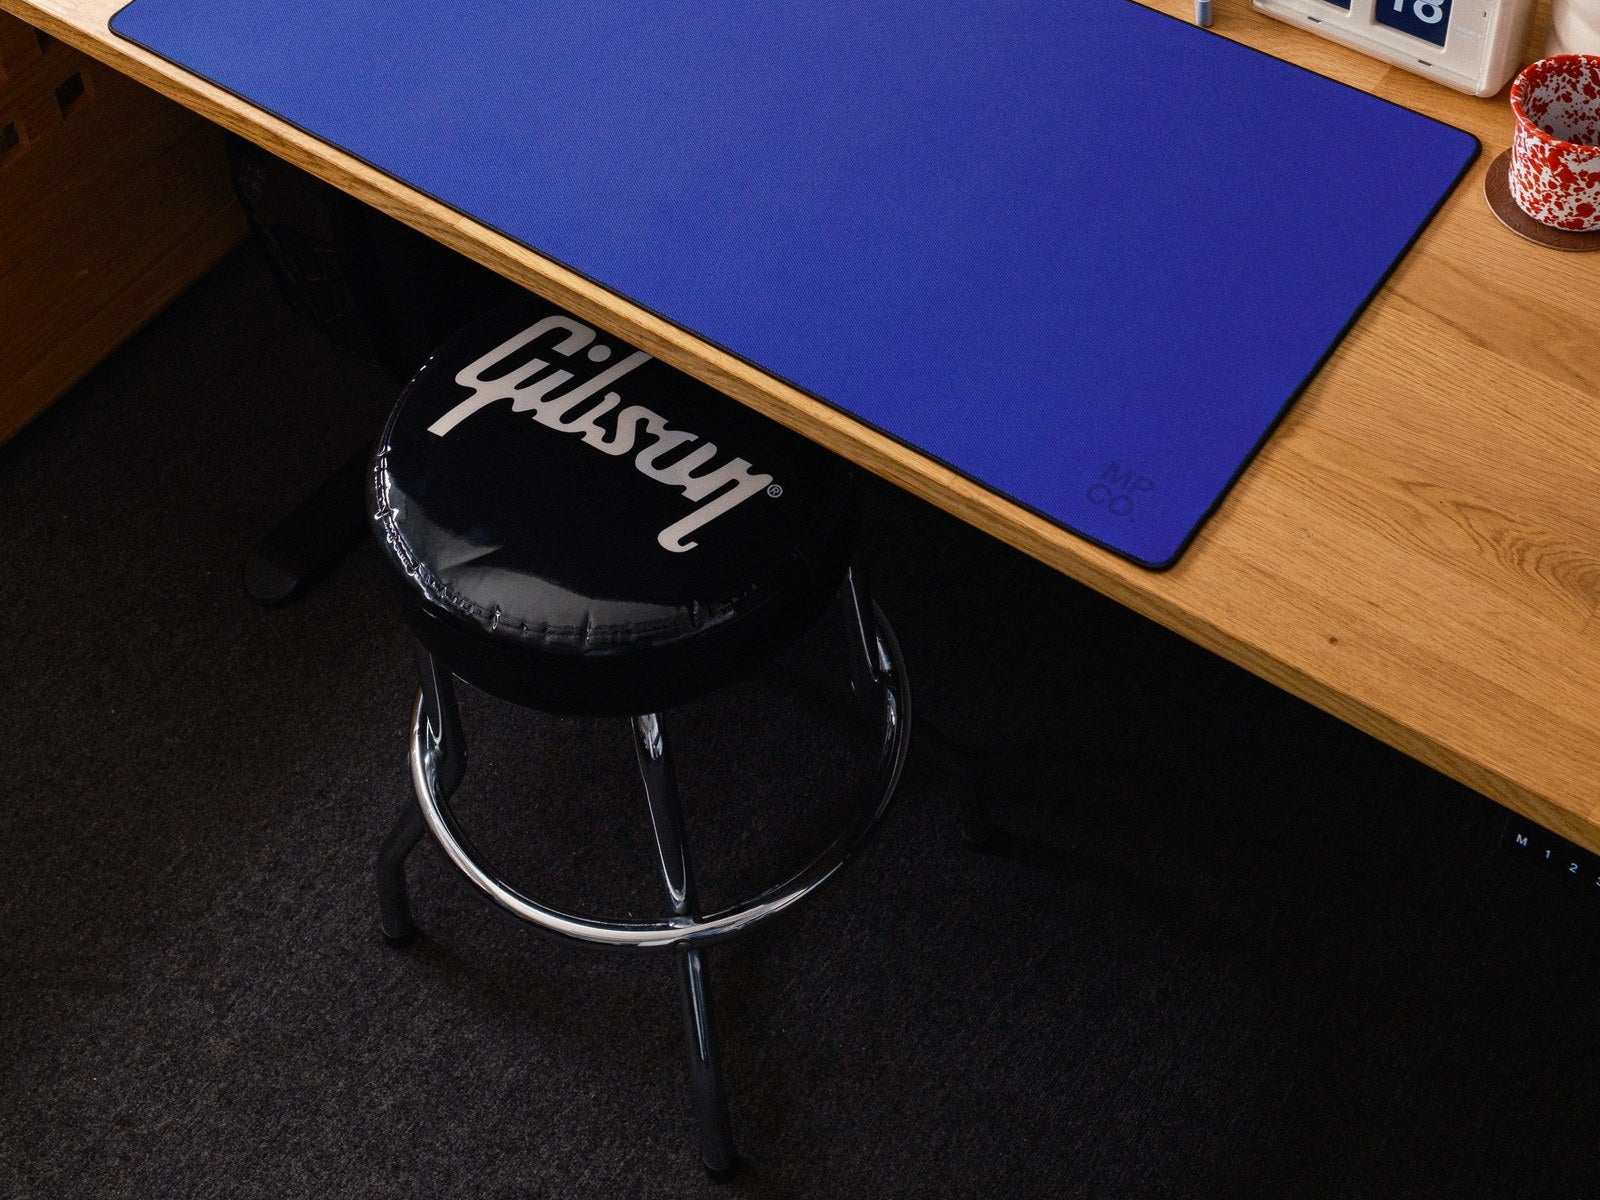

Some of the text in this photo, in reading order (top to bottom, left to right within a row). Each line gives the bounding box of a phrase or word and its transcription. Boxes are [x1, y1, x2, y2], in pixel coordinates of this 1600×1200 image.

[1516, 834, 1578, 873] M 1 2
